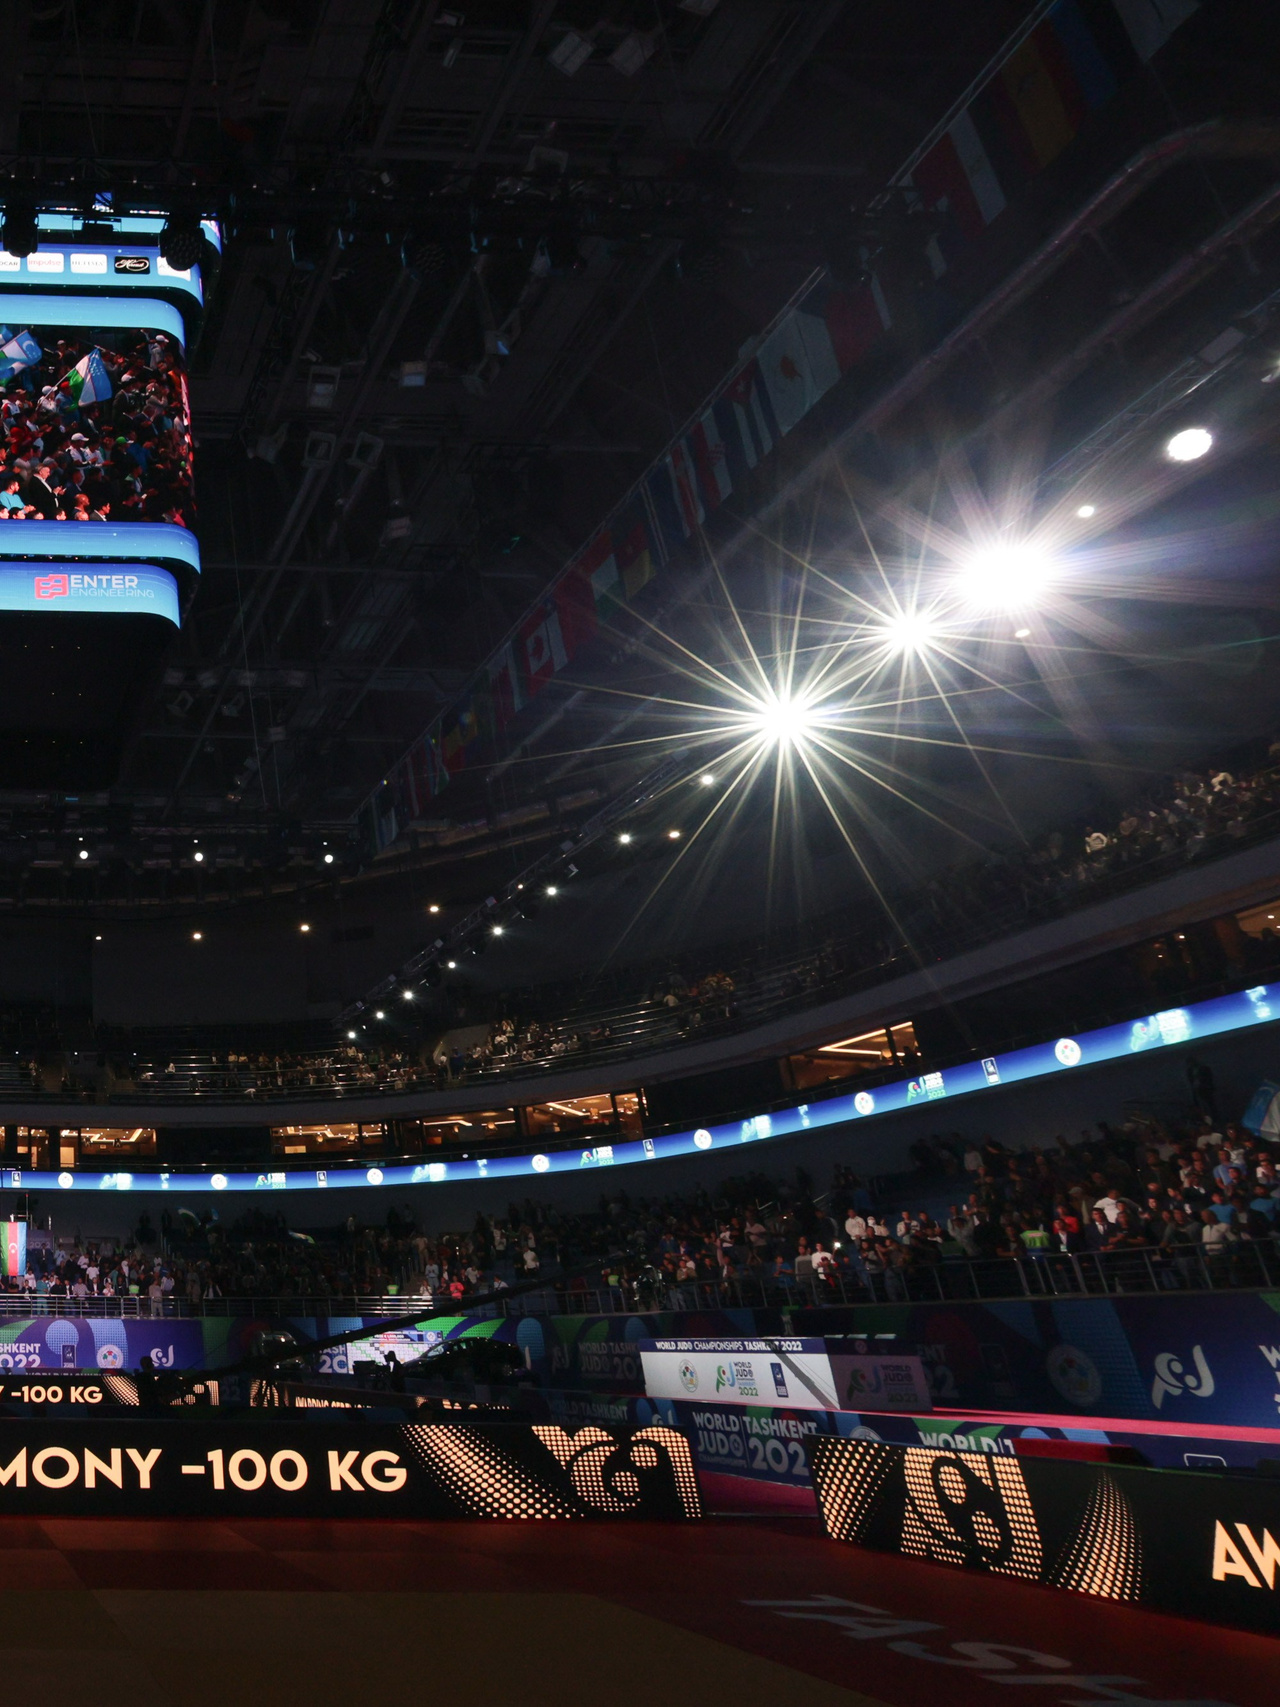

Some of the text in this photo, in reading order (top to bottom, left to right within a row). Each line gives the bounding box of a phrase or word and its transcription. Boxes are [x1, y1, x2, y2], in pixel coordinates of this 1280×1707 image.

[70, 574, 138, 588] ENTER
[70, 588, 155, 598] ENGINEERING
[655, 1341, 676, 1350] WORLD
[677, 1341, 693, 1350] JUDO
[694, 1341, 744, 1351] CHAMPIONSHIPS
[781, 1342, 803, 1351] 2022
[733, 1361, 752, 1369] WORLD
[735, 1369, 754, 1378] JUDO
[11, 1386, 63, 1404] -100
[70, 1386, 103, 1404] KG
[738, 1386, 759, 1397] 2022
[692, 1411, 818, 1439] WORLD TASHKENT
[696, 1430, 810, 1477] JUDO 202
[181, 1448, 309, 1492] -100
[328, 1450, 410, 1493] KG
